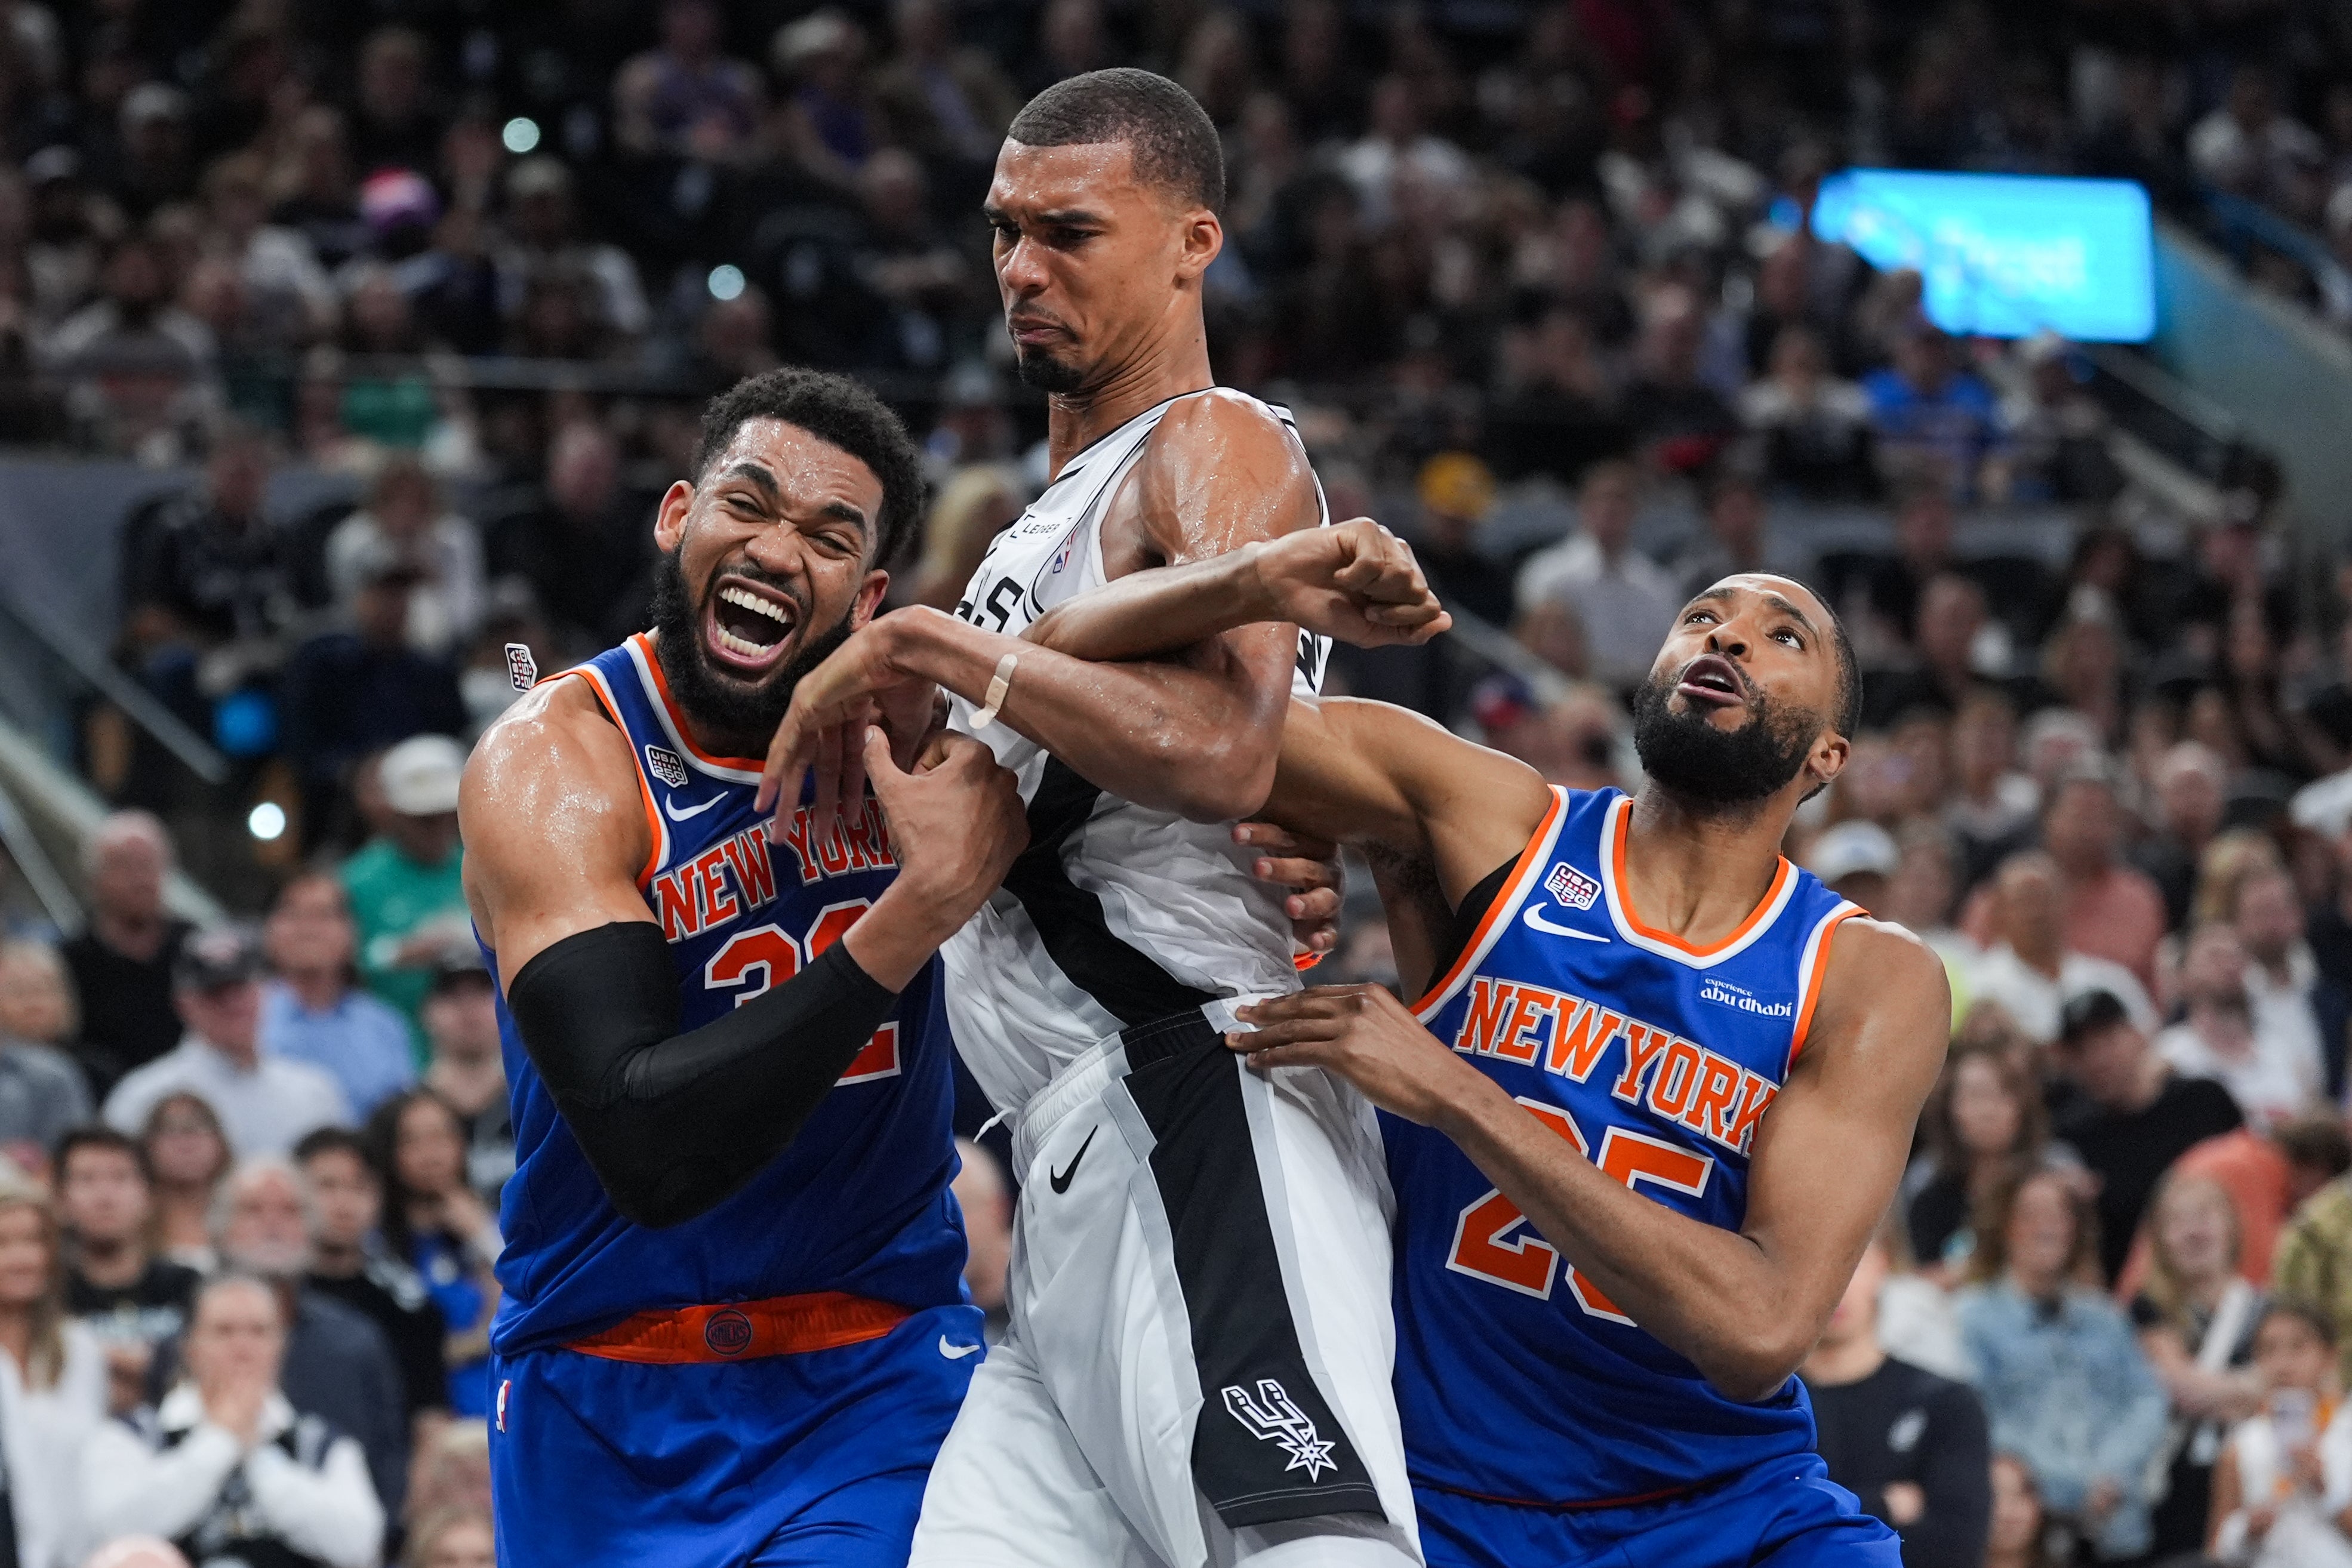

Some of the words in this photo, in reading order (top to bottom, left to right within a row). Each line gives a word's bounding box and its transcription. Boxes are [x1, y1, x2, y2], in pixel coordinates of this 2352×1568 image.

[510, 649, 521, 685] USA
[519, 649, 531, 689] 250
[651, 750, 679, 765] USA
[654, 765, 685, 781] 250
[652, 817, 780, 944] NEW
[1548, 879, 1589, 908] 250
[1559, 867, 1593, 894] USA
[1700, 987, 1736, 1006] abu
[1705, 978, 1753, 997] experience
[1452, 975, 1623, 1084] NEW
[1611, 1018, 1780, 1157] YORK
